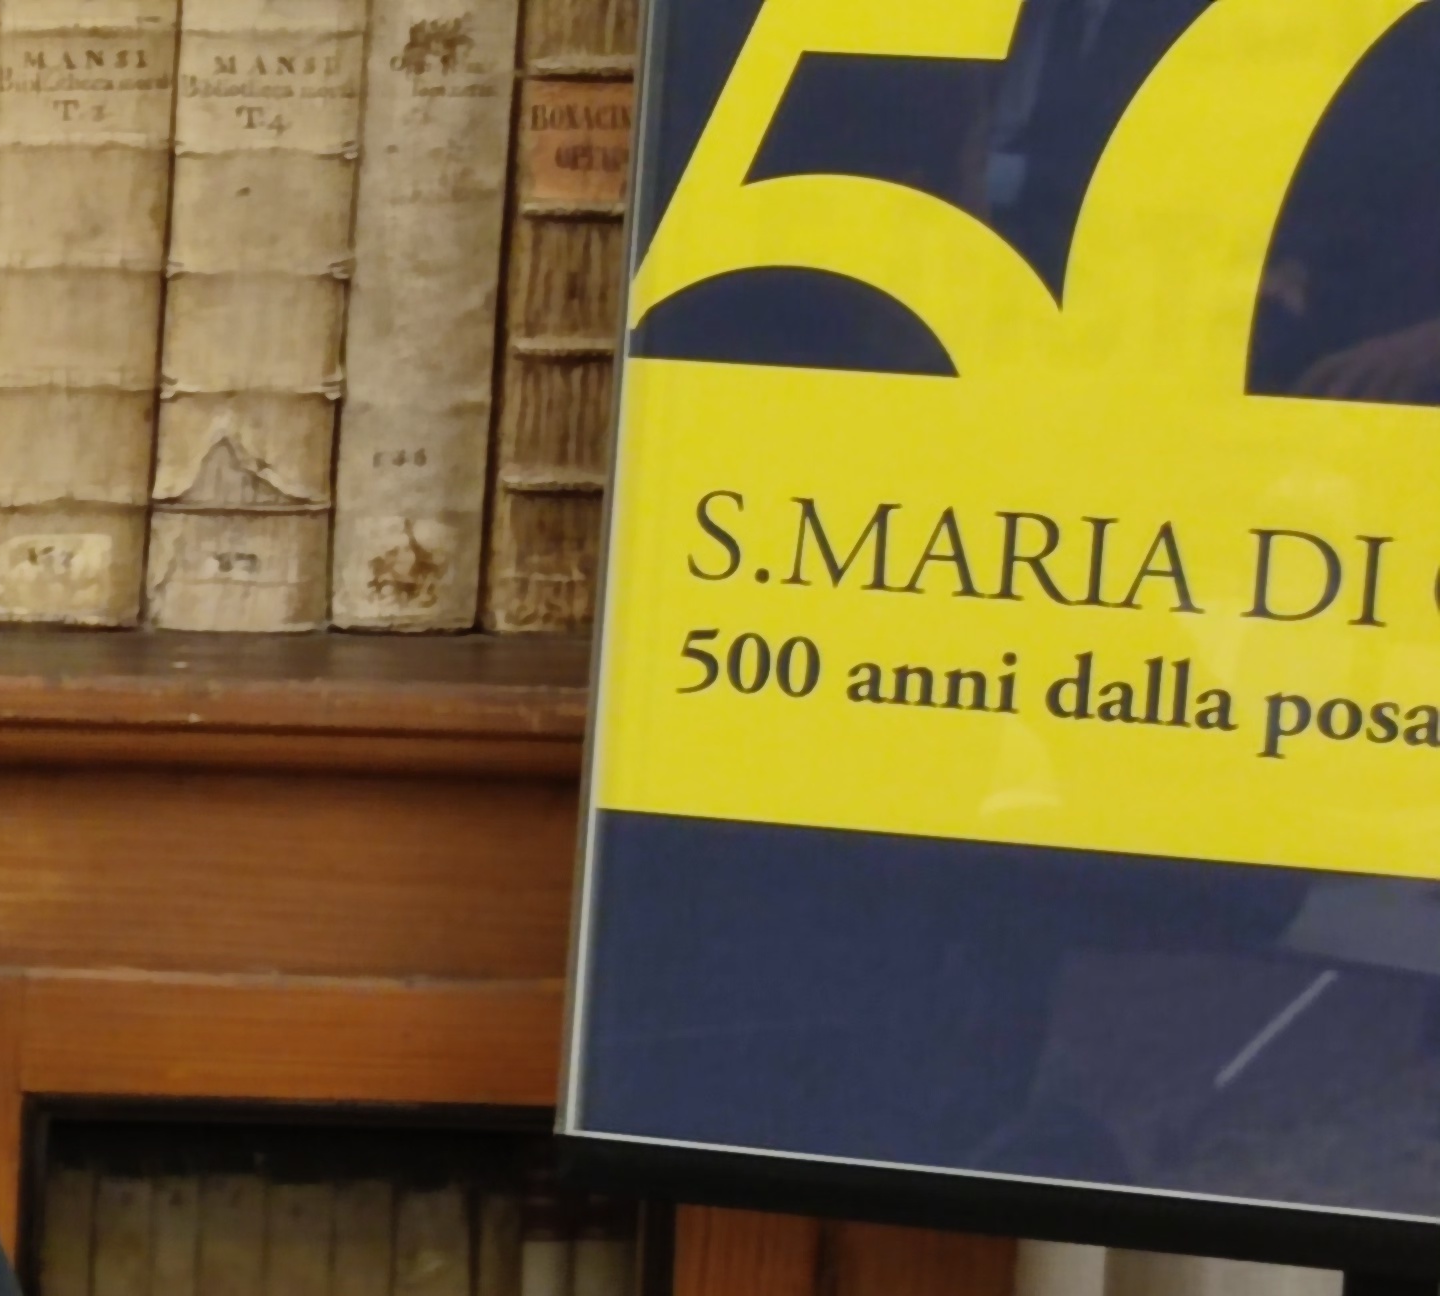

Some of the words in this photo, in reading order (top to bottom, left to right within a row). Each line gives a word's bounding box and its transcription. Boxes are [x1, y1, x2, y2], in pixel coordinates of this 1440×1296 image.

[686, 489, 1207, 615] S.MARIA
[1239, 527, 1397, 628] DI
[676, 627, 822, 698] 500
[846, 652, 1021, 715] anni
[1045, 651, 1239, 732] dalla
[1257, 690, 1440, 760] posa
